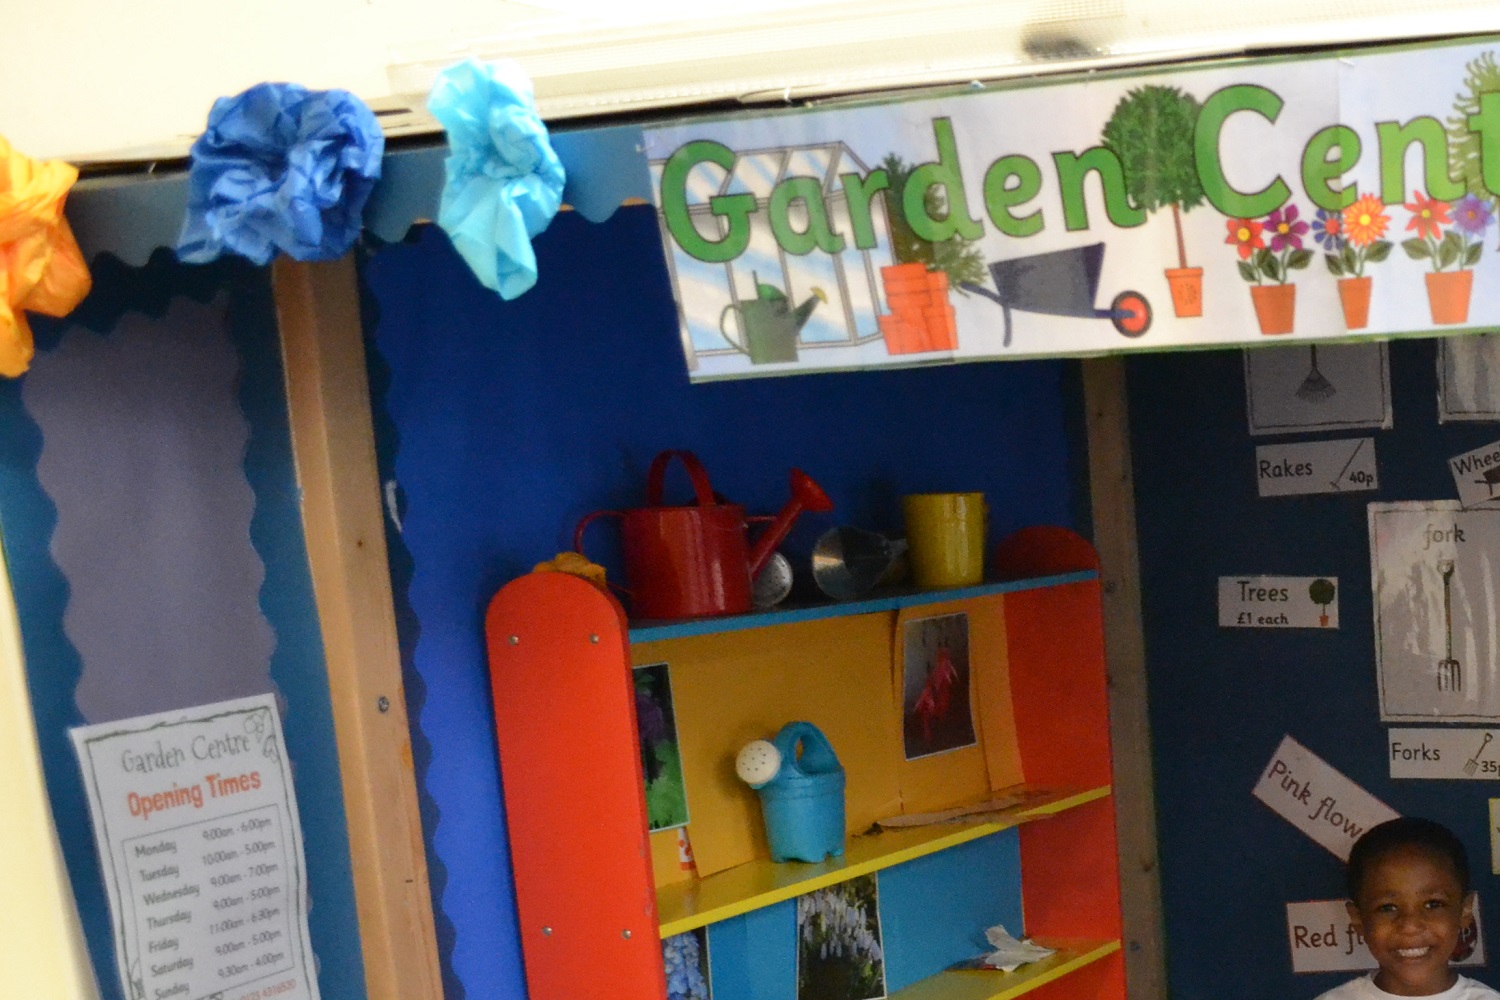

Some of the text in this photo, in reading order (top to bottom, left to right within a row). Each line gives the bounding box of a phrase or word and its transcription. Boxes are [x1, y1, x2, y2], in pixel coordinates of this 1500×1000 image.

[659, 115, 1148, 264] Garden
[1259, 460, 1314, 478] Rakes
[1348, 470, 1374, 487] 40p
[1423, 523, 1466, 550] fork
[1237, 580, 1289, 602] Trees
[1236, 612, 1289, 625] £1 each
[122, 733, 250, 774] Garden Centre
[1391, 744, 1441, 762] Forks
[127, 771, 261, 820] Opening Times
[1268, 760, 1363, 839] Pink flow
[134, 840, 177, 858] Monday
[139, 865, 180, 882] Tuesday
[142, 884, 200, 906] Wednesday
[146, 910, 192, 930] Thursday
[149, 937, 179, 954] Friday
[1294, 923, 1338, 949] Red
[151, 957, 194, 977] Saturday
[154, 982, 190, 1000] Sunday
